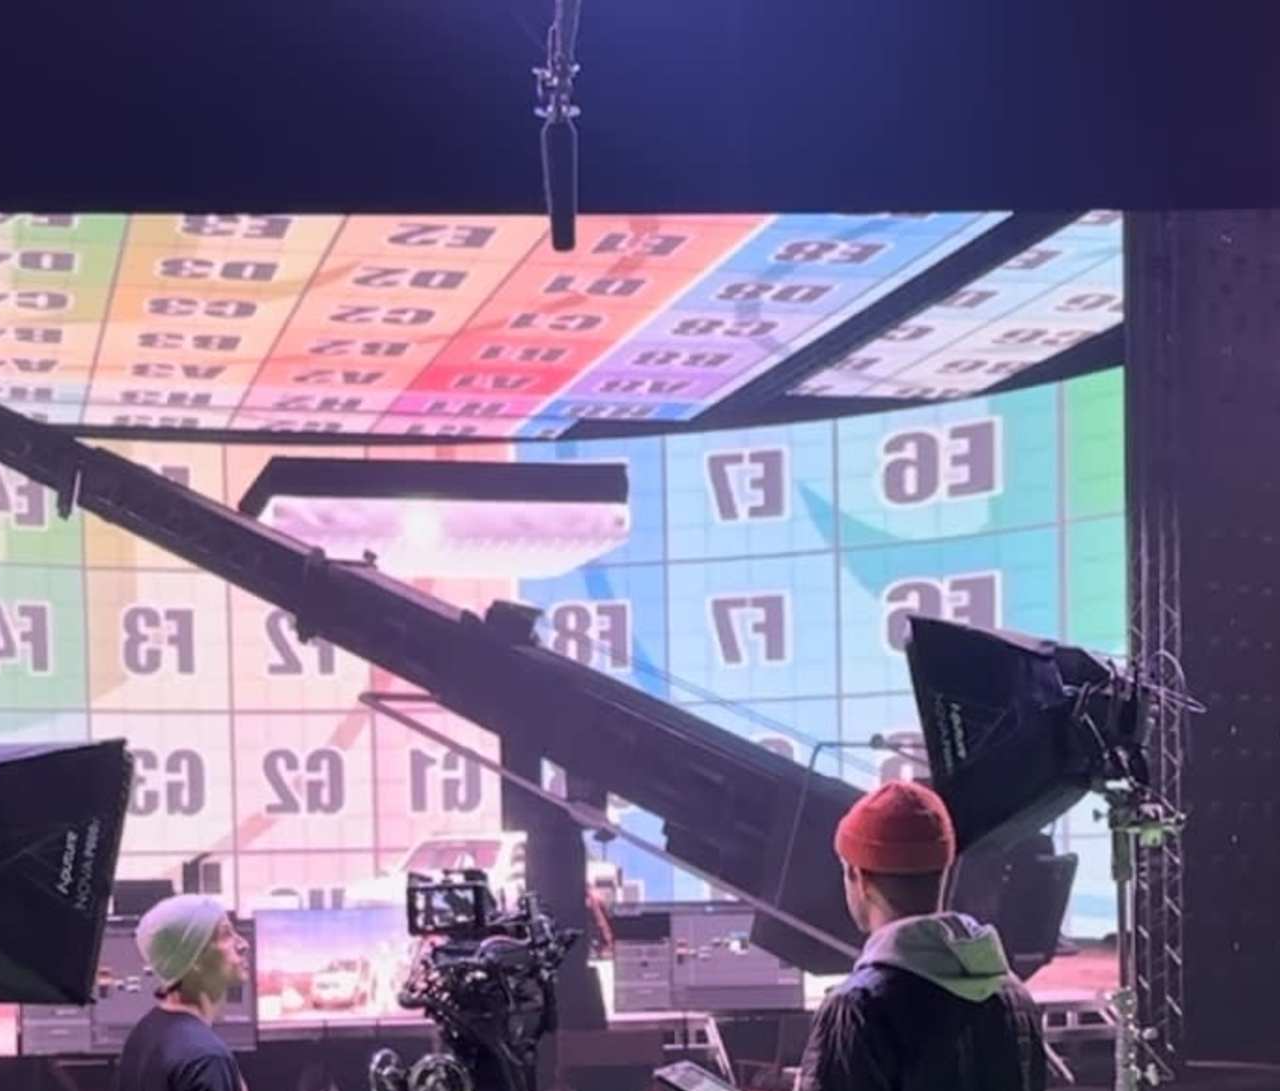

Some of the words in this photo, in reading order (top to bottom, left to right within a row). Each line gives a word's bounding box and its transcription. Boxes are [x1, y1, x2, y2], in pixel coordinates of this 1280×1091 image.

[387, 222, 497, 248] E2
[591, 232, 689, 256] E1
[773, 240, 888, 263] E8
[159, 257, 278, 282] D3
[352, 266, 469, 290] D2
[543, 275, 647, 297] D1
[147, 297, 257, 319] C3
[329, 304, 436, 326] C2
[509, 312, 604, 332] C1
[138, 332, 240, 350] B3
[308, 338, 410, 357] B2
[130, 362, 227, 379] A3
[292, 368, 386, 385] A2
